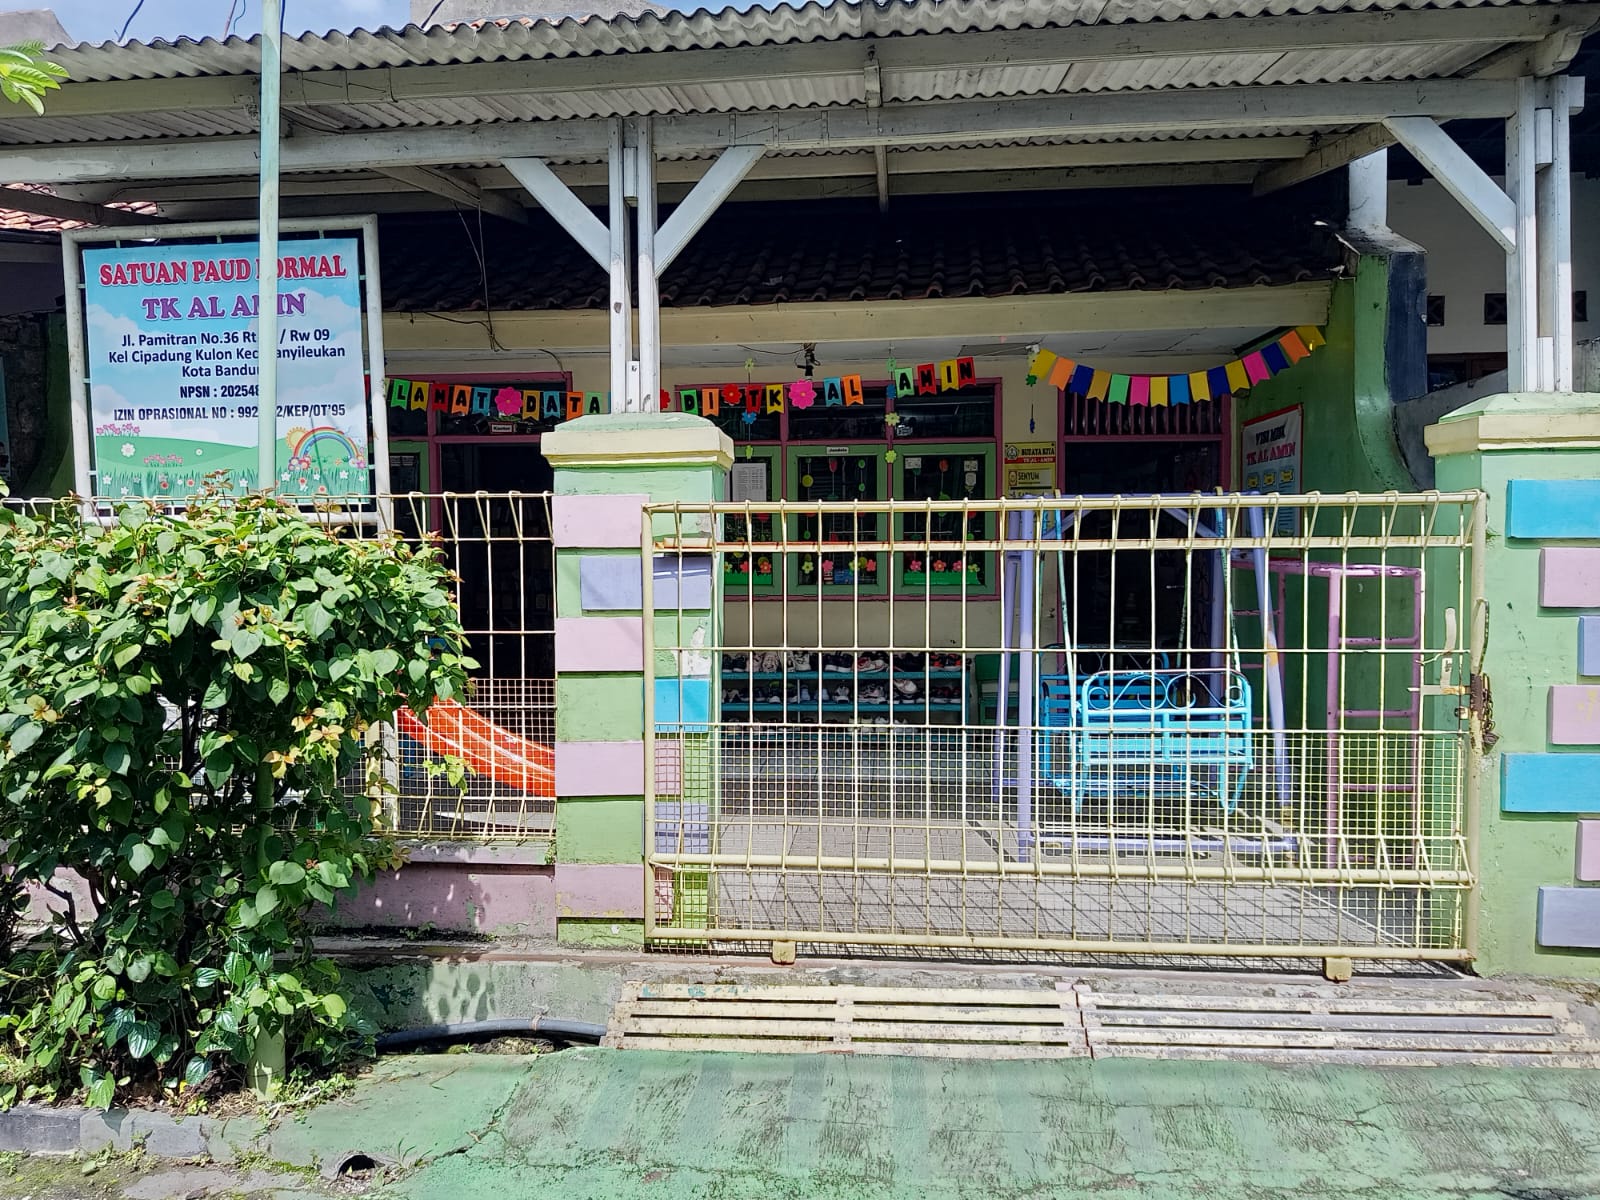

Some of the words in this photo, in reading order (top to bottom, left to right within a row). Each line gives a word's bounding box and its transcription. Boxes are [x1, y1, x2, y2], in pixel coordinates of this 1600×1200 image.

[100, 261, 188, 286] SATUAN
[192, 259, 251, 282] PAUD
[256, 255, 347, 279] RMAL
[142, 297, 182, 320] TK
[187, 296, 226, 319] AL
[122, 333, 135, 347] Jl.
[139, 333, 197, 346] Pamitran
[200, 331, 239, 345] No.36
[290, 330, 311, 341] Rw
[313, 328, 330, 341] 09
[109, 351, 128, 363] Kel
[132, 349, 192, 365] Cipadung
[195, 348, 233, 361] Kulon
[276, 344, 346, 361] anyileukan
[182, 365, 211, 378] Kota
[215, 363, 259, 377] Bandu
[180, 385, 210, 398] NPSN
[220, 384, 259, 398] 202548
[398, 384, 489, 410] LAMAT
[525, 394, 601, 414] DATA
[683, 391, 716, 410] DI
[749, 388, 782, 407] TK
[827, 379, 861, 400] AL
[898, 361, 974, 391] AMIN
[113, 409, 135, 421] IZIN
[138, 406, 208, 420] OPRASIONAL
[212, 406, 227, 419] NO
